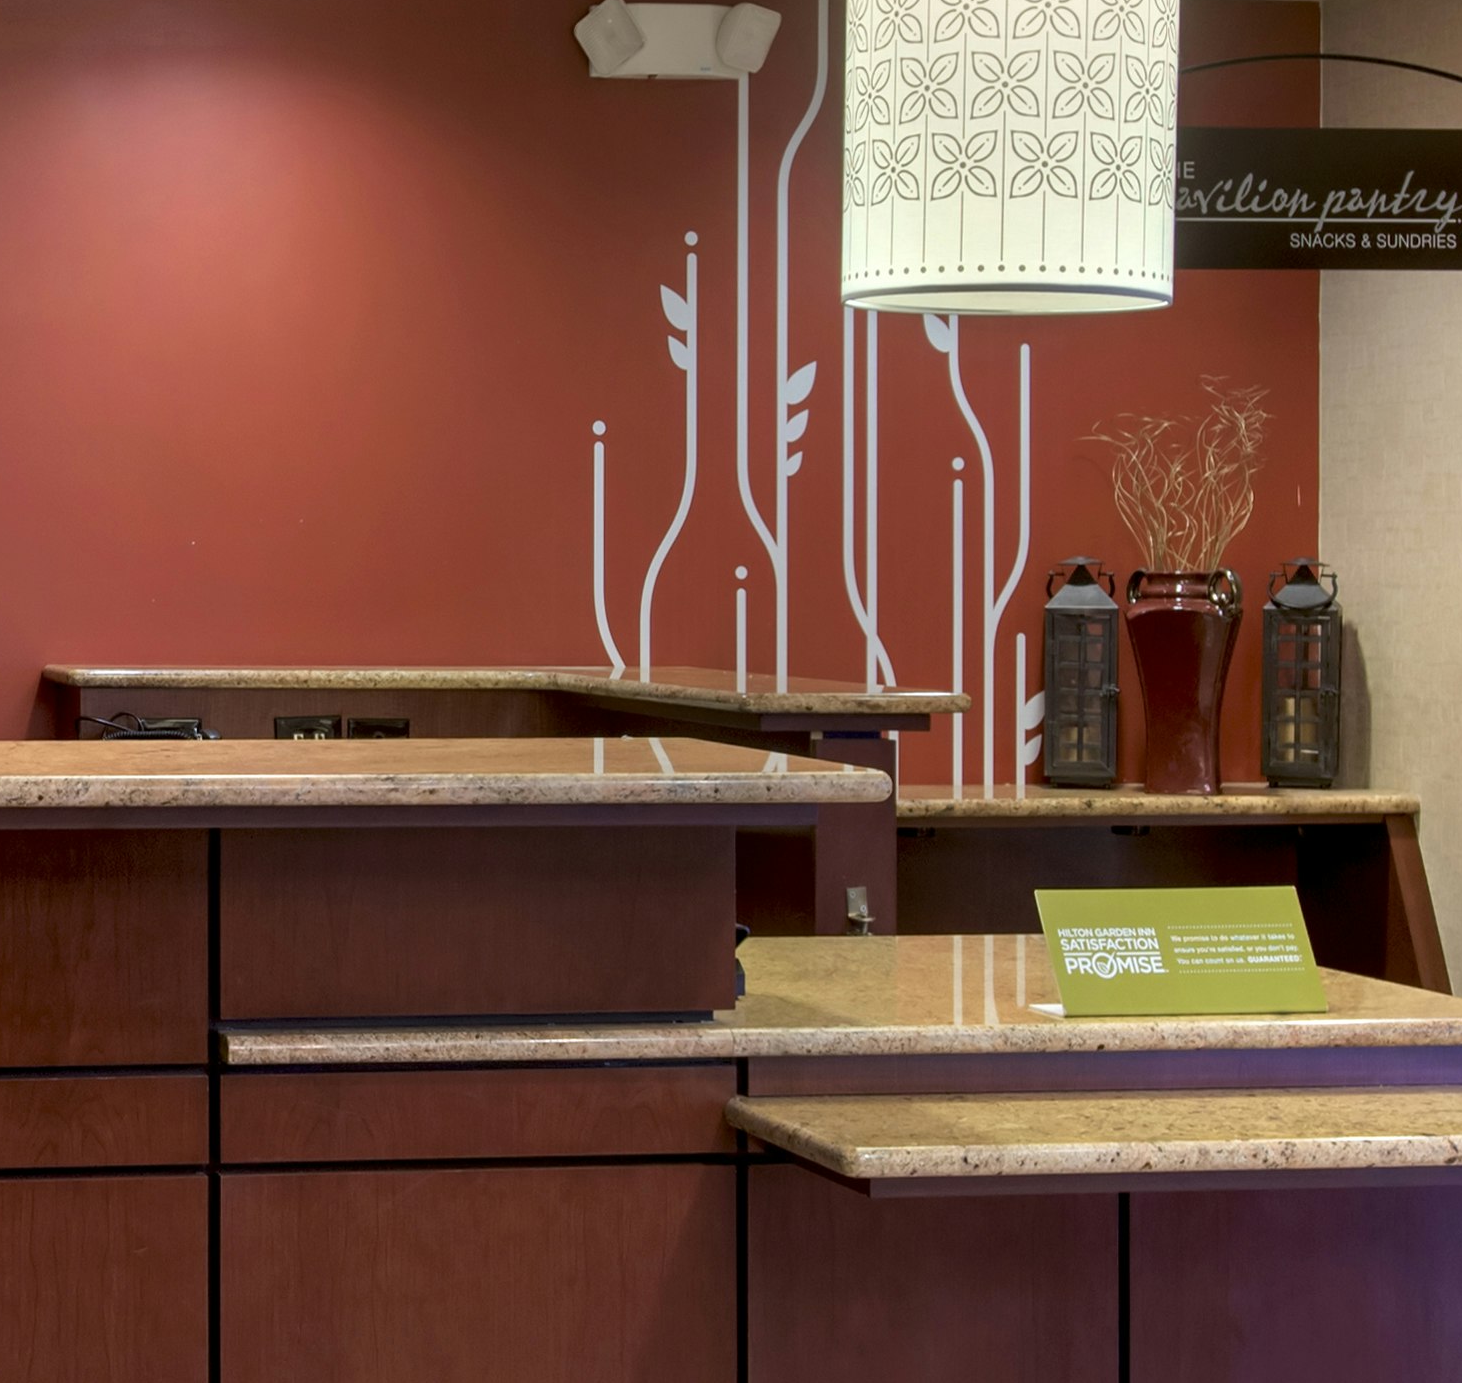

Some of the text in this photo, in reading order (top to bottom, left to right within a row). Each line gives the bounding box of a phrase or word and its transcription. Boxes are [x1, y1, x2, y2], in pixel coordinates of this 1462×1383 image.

[1175, 173, 1317, 218] avilion
[1290, 233, 1457, 249] SNACKS & SUNDRIES
[1057, 927, 1156, 937] HILTON GARDEN INN
[1060, 938, 1159, 951] SATISFACTION
[1064, 951, 1165, 979] PROMISE
